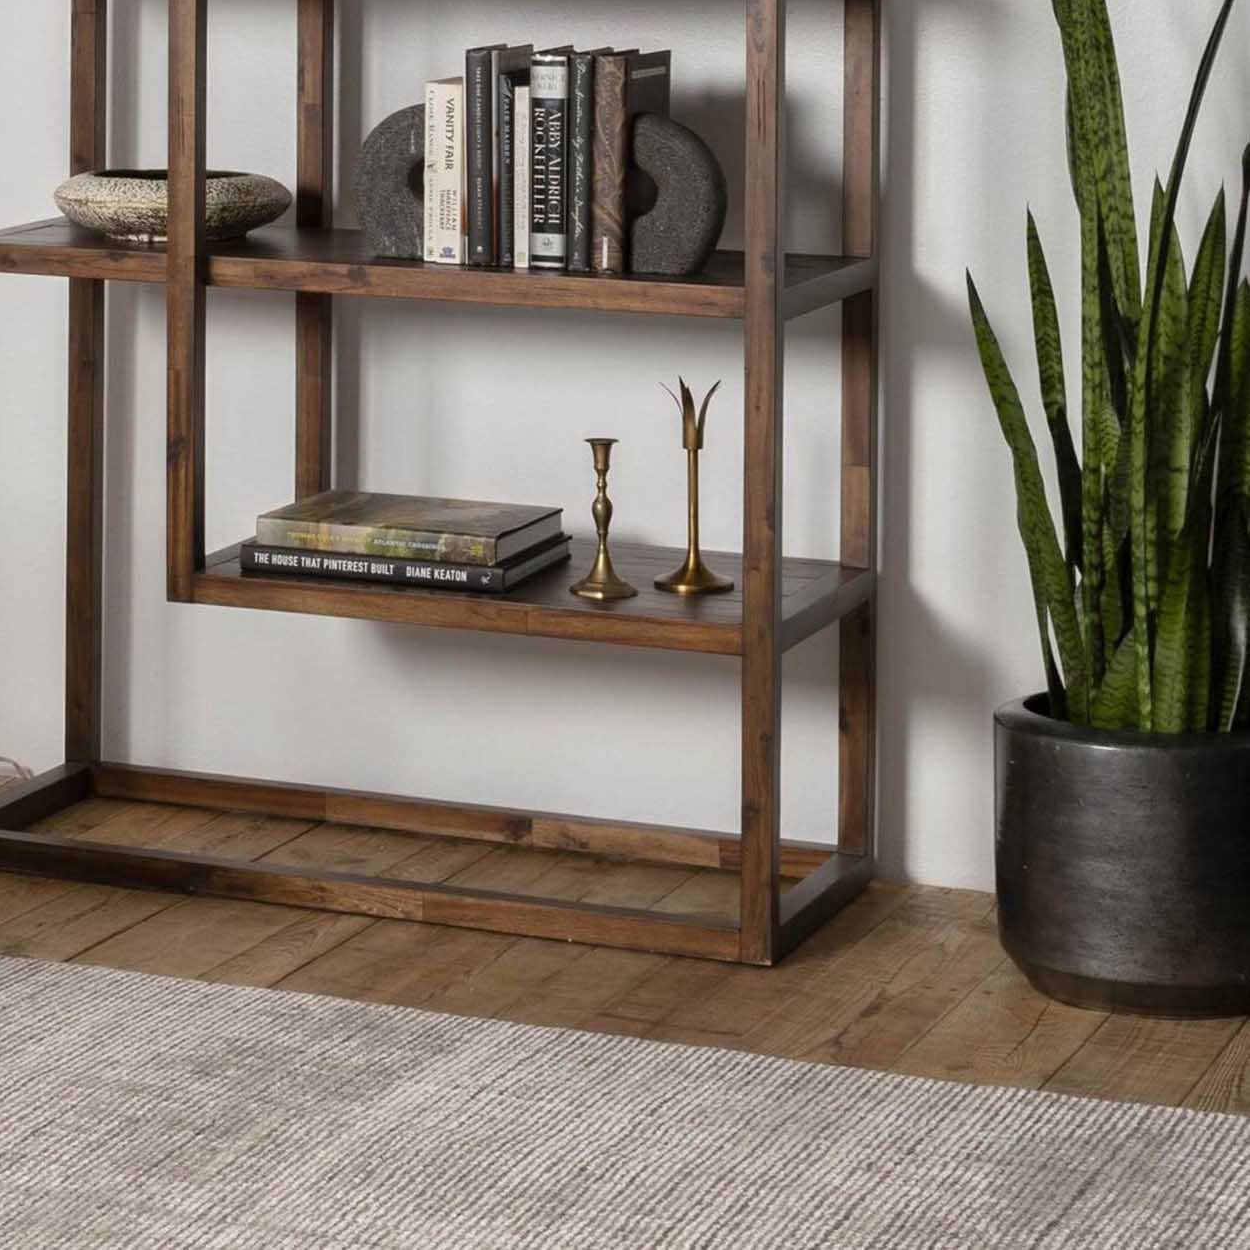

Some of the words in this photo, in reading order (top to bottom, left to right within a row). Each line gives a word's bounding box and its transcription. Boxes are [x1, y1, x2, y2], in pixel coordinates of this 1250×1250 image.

[445, 98, 455, 143] VANITY
[548, 110, 562, 151] ABBY
[445, 145, 455, 171] FAIR
[533, 108, 547, 224] ROCKEFELLER
[547, 154, 562, 224] ALDRICH
[253, 552, 270, 565] THE
[271, 554, 299, 567] HOUSE
[300, 556, 321, 569] THAT
[323, 559, 369, 573] PINTEREST
[370, 562, 395, 575] BUILT
[406, 566, 431, 579] DIANE
[434, 569, 467, 582] KEATON
